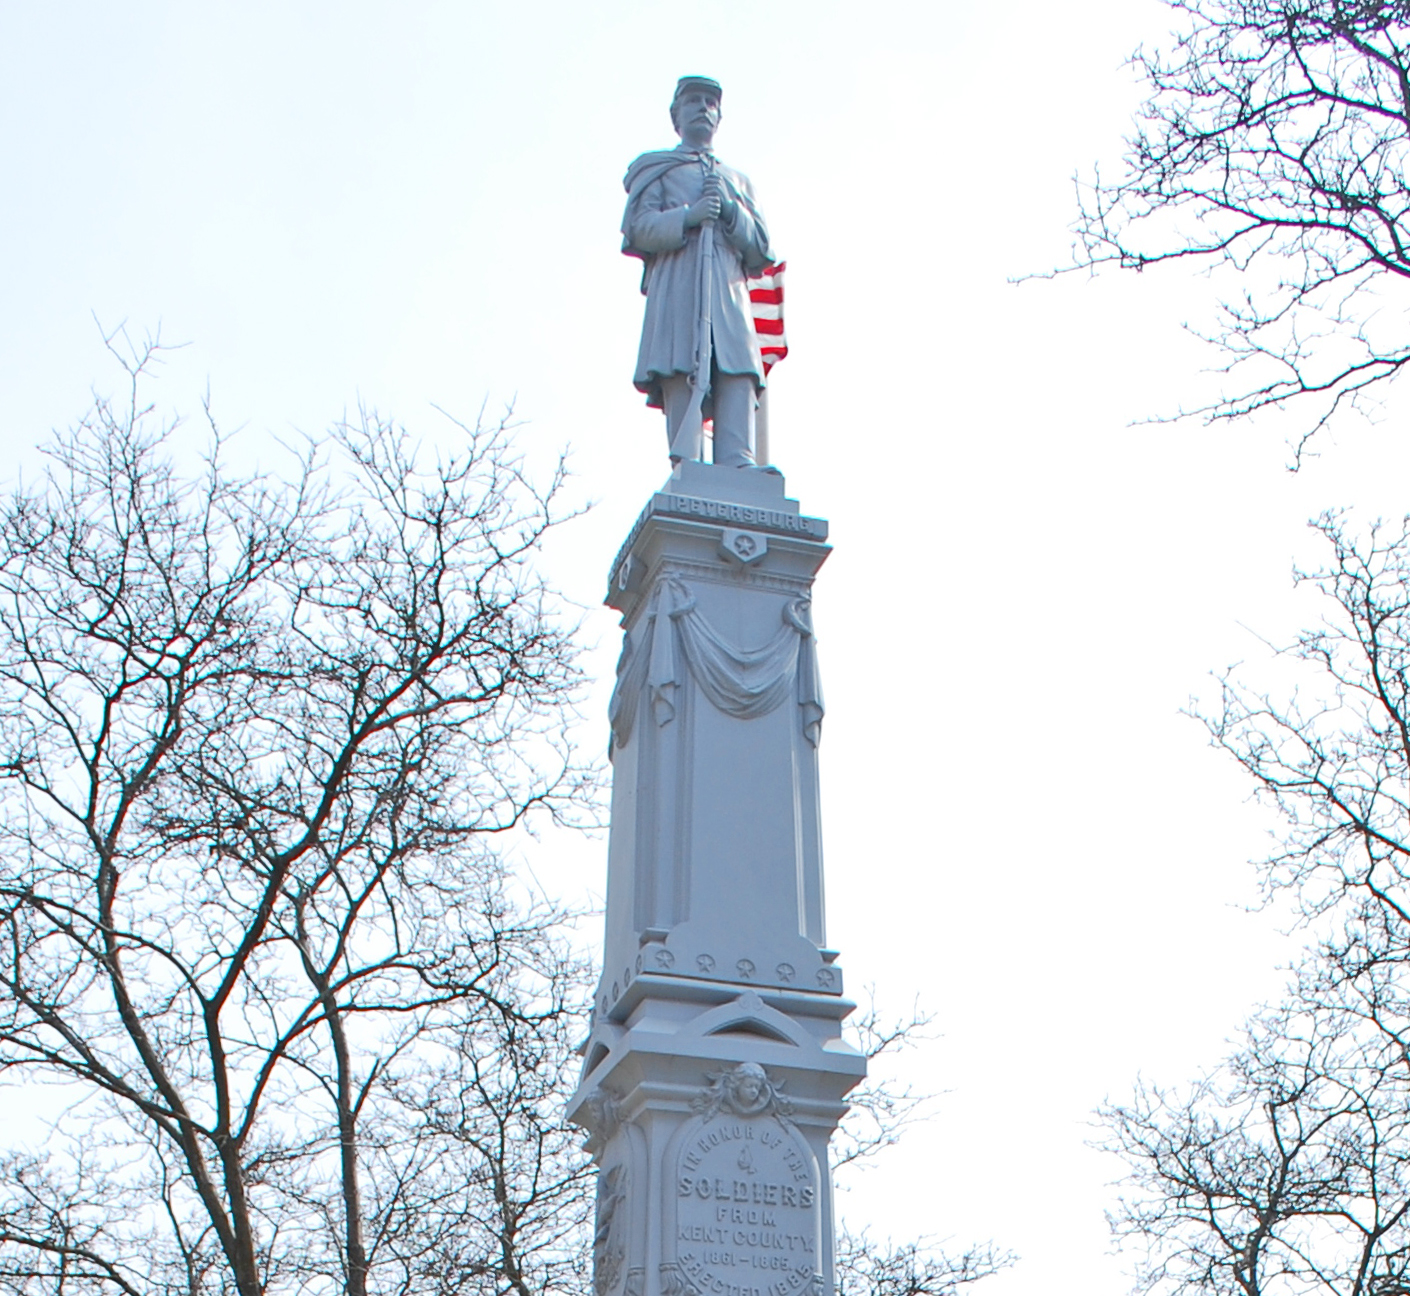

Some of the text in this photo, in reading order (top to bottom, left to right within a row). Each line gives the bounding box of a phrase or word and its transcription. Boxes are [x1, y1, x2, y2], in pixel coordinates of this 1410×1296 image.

[677, 498, 810, 530] PETERSBURG
[683, 1126, 809, 1183] IN HONOR OF THE
[679, 1177, 814, 1208] SOLDIERS
[718, 1208, 776, 1228] FROM
[678, 1224, 730, 1246] KENT
